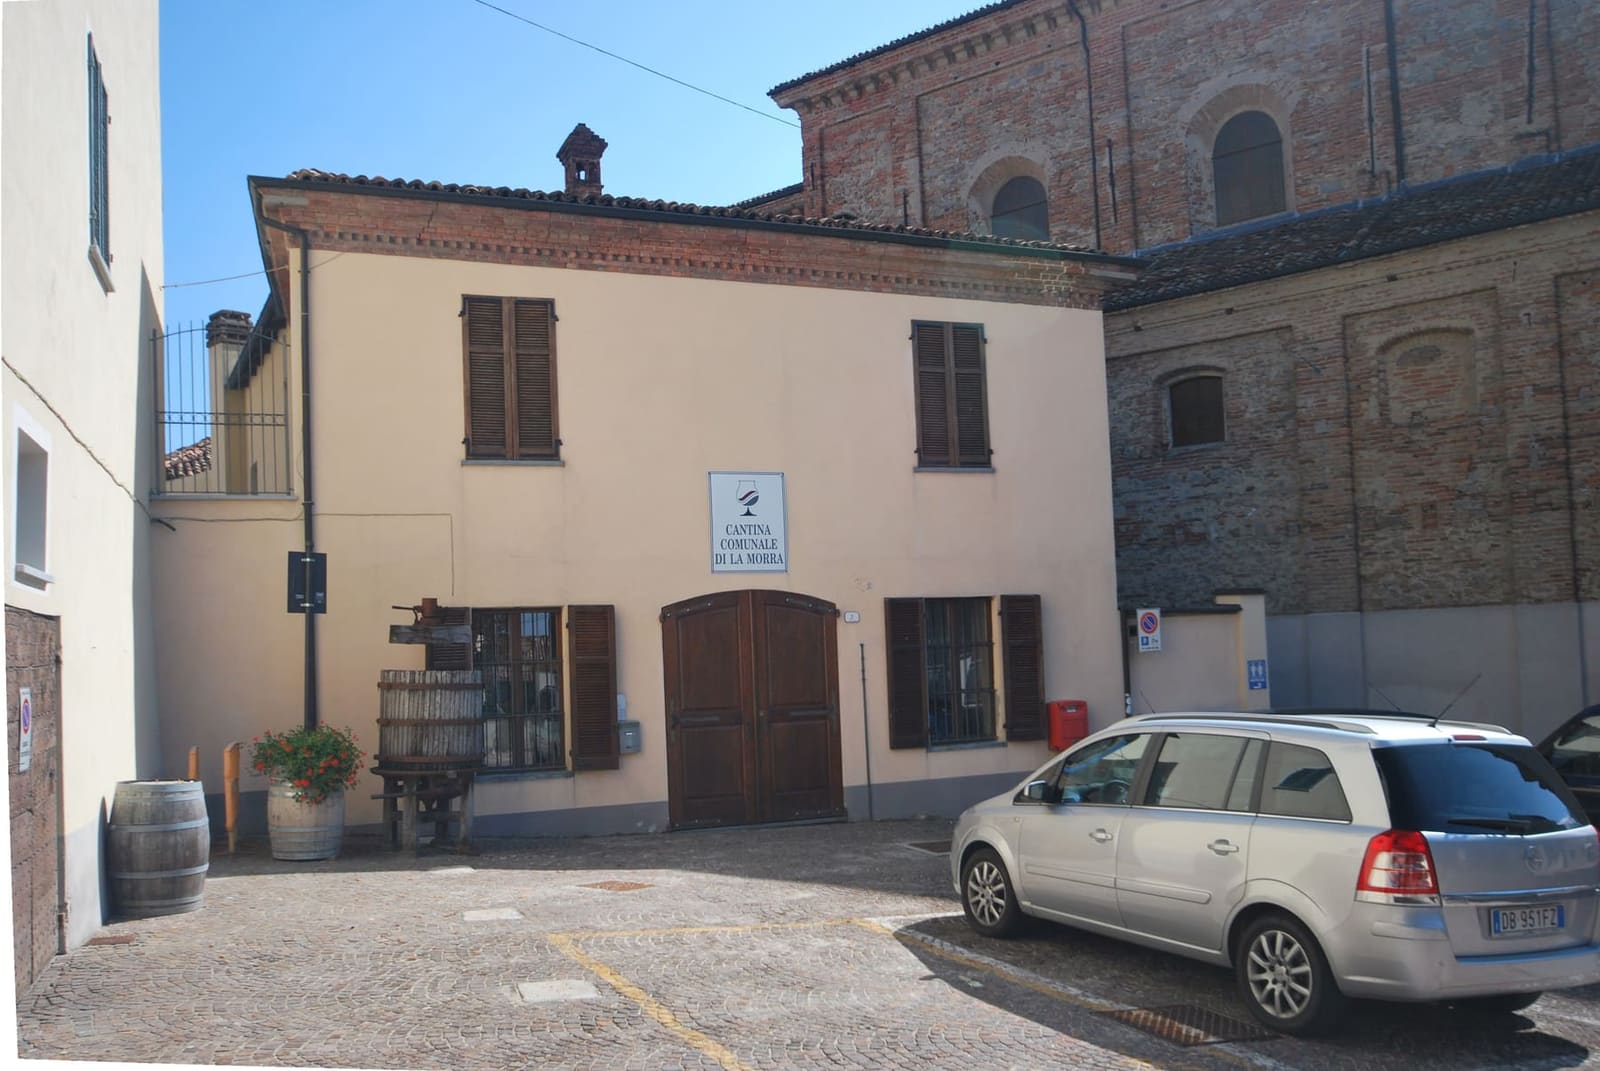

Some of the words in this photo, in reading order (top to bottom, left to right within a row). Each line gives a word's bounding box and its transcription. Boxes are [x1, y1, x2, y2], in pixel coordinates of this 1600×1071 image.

[726, 524, 771, 536] CANTINA
[720, 538, 778, 550] COMUNALE
[715, 553, 726, 565] DI
[730, 553, 743, 565] LA
[747, 552, 784, 565] MORRA
[1502, 911, 1517, 930] DB
[1521, 908, 1557, 928] 951FZ
